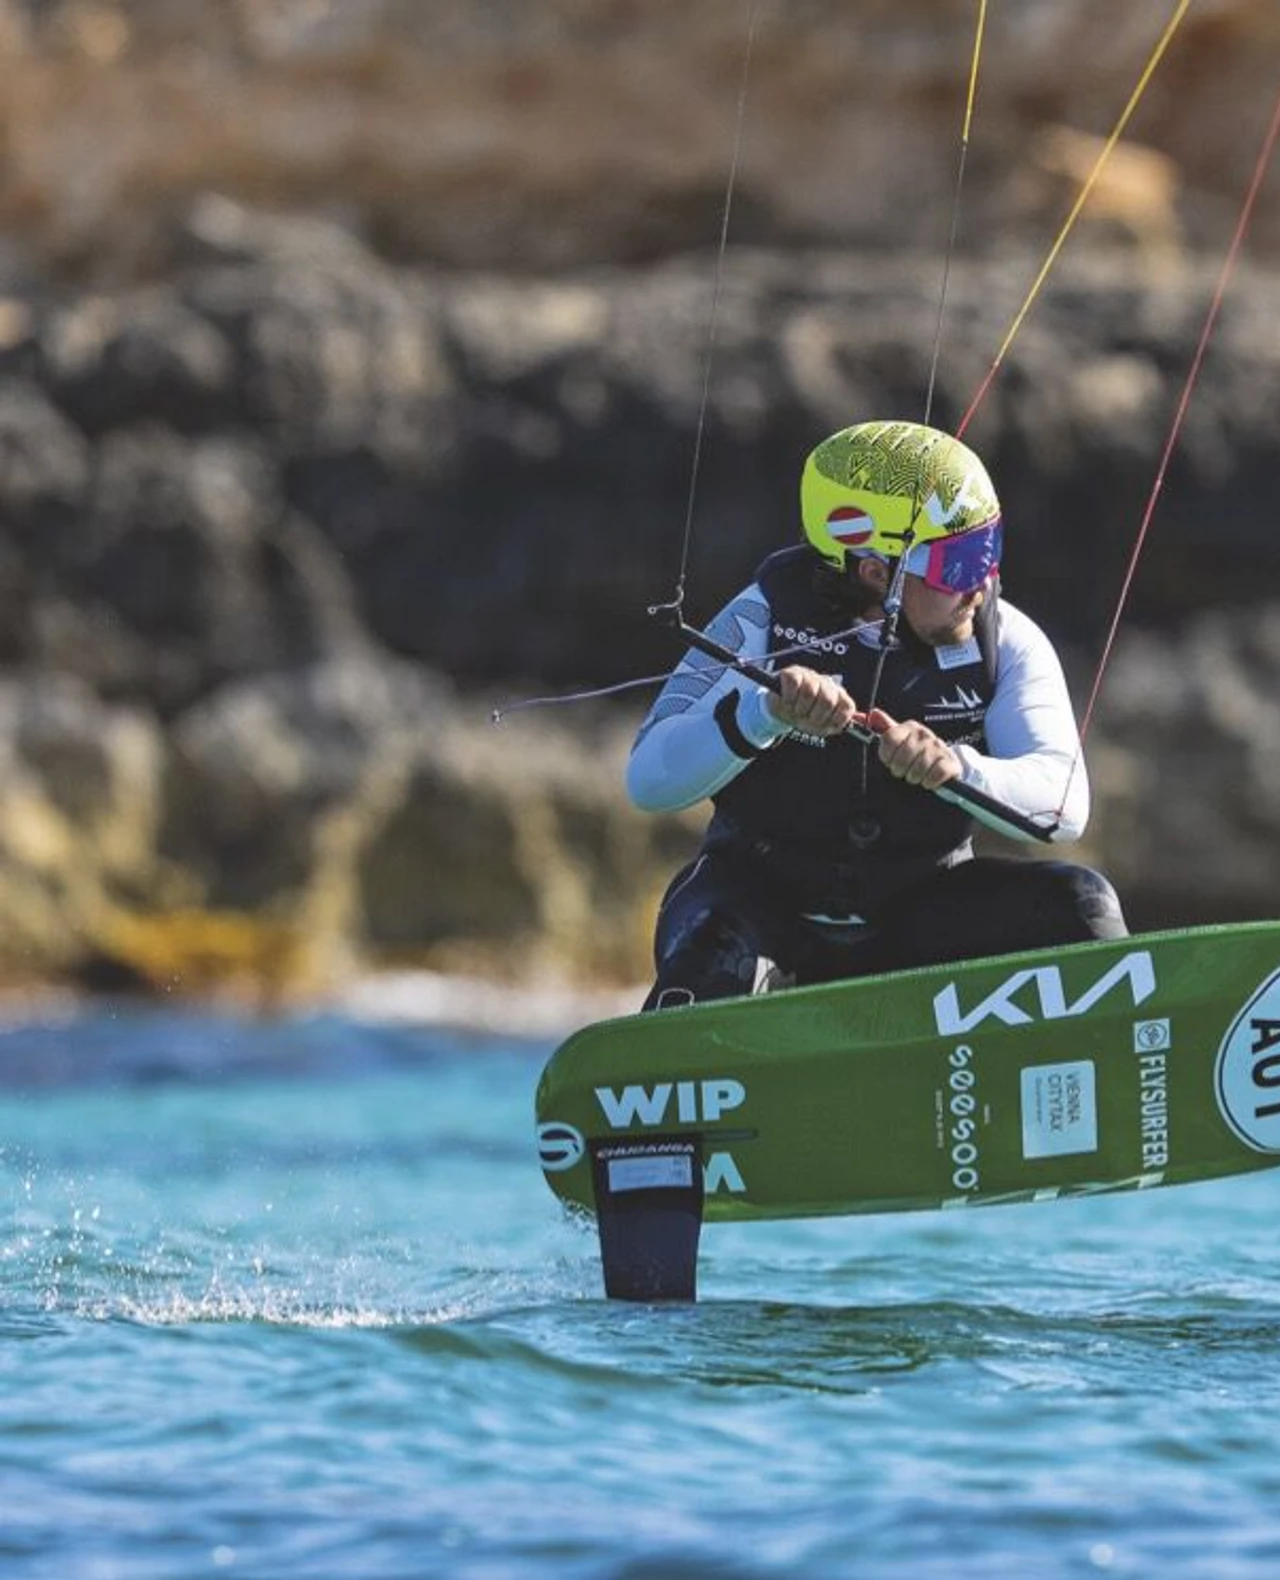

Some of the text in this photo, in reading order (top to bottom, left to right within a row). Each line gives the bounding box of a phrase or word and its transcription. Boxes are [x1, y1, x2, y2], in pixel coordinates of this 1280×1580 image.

[933, 950, 1157, 1036] KIA
[595, 1078, 746, 1128] WIP
[949, 1044, 978, 1189] seesoo
[1139, 1053, 1169, 1169] FLYSURFER
